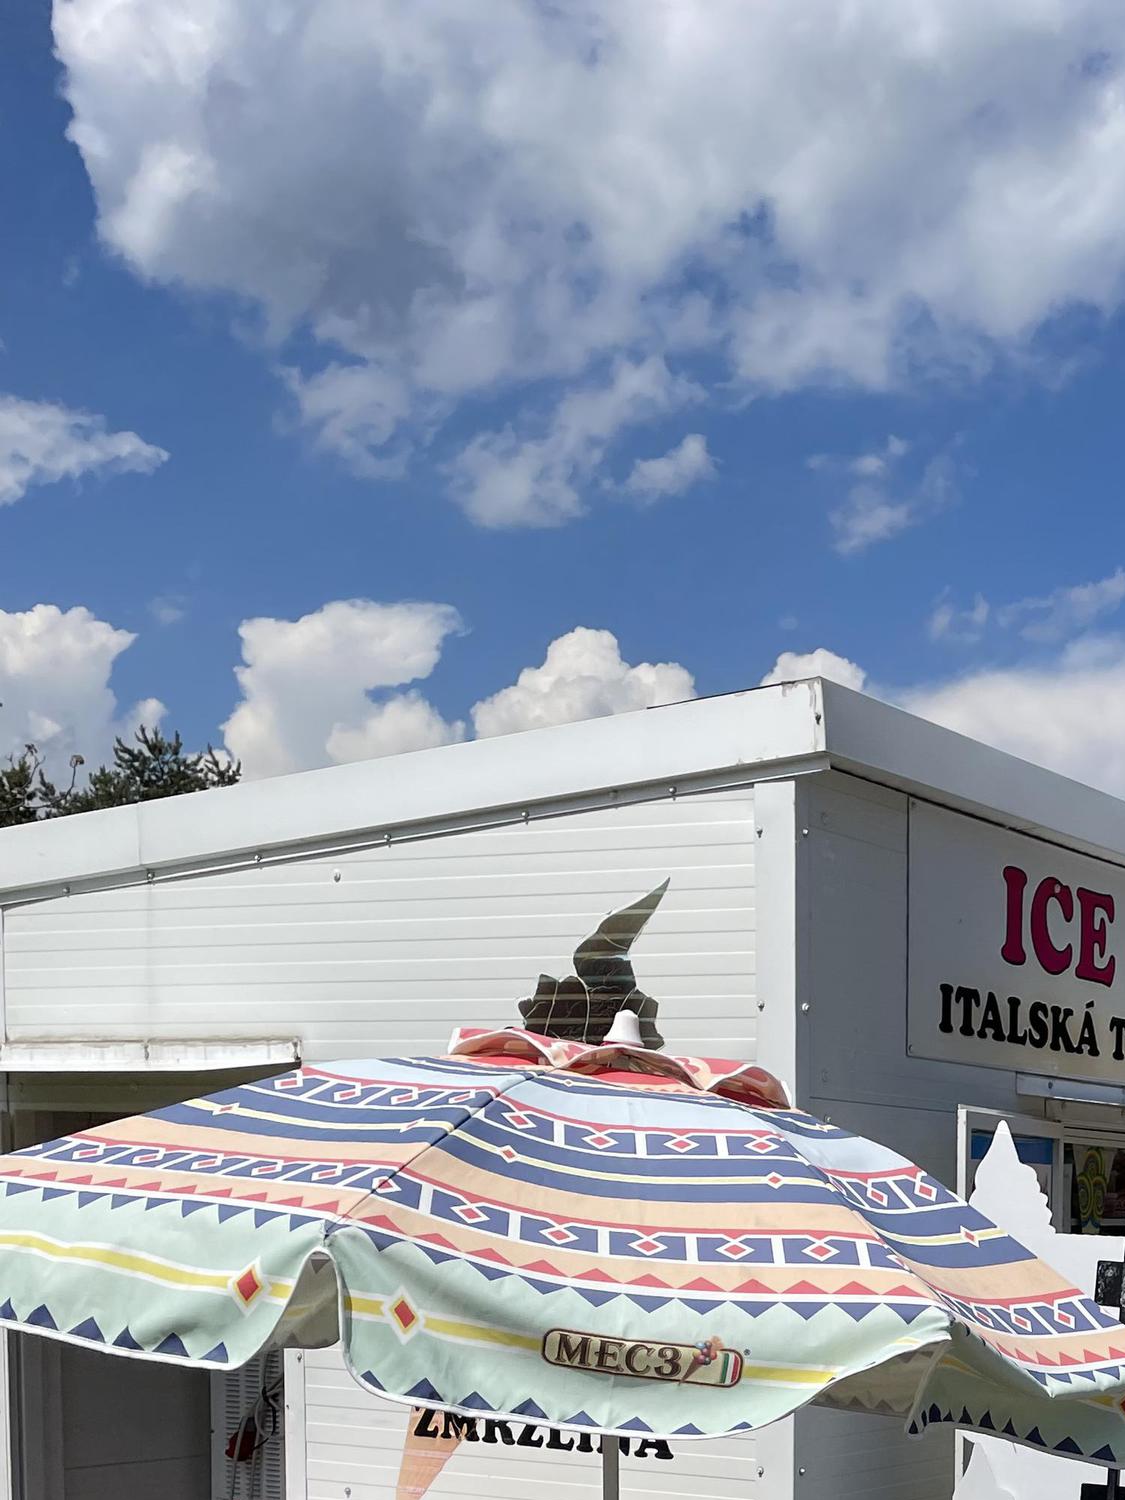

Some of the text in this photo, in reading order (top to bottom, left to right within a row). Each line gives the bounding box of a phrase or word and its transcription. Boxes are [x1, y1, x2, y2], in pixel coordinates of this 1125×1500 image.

[1001, 866, 1115, 988] ICE
[939, 984, 1100, 1057] ITALSKÁ
[555, 1333, 682, 1378] MEC3
